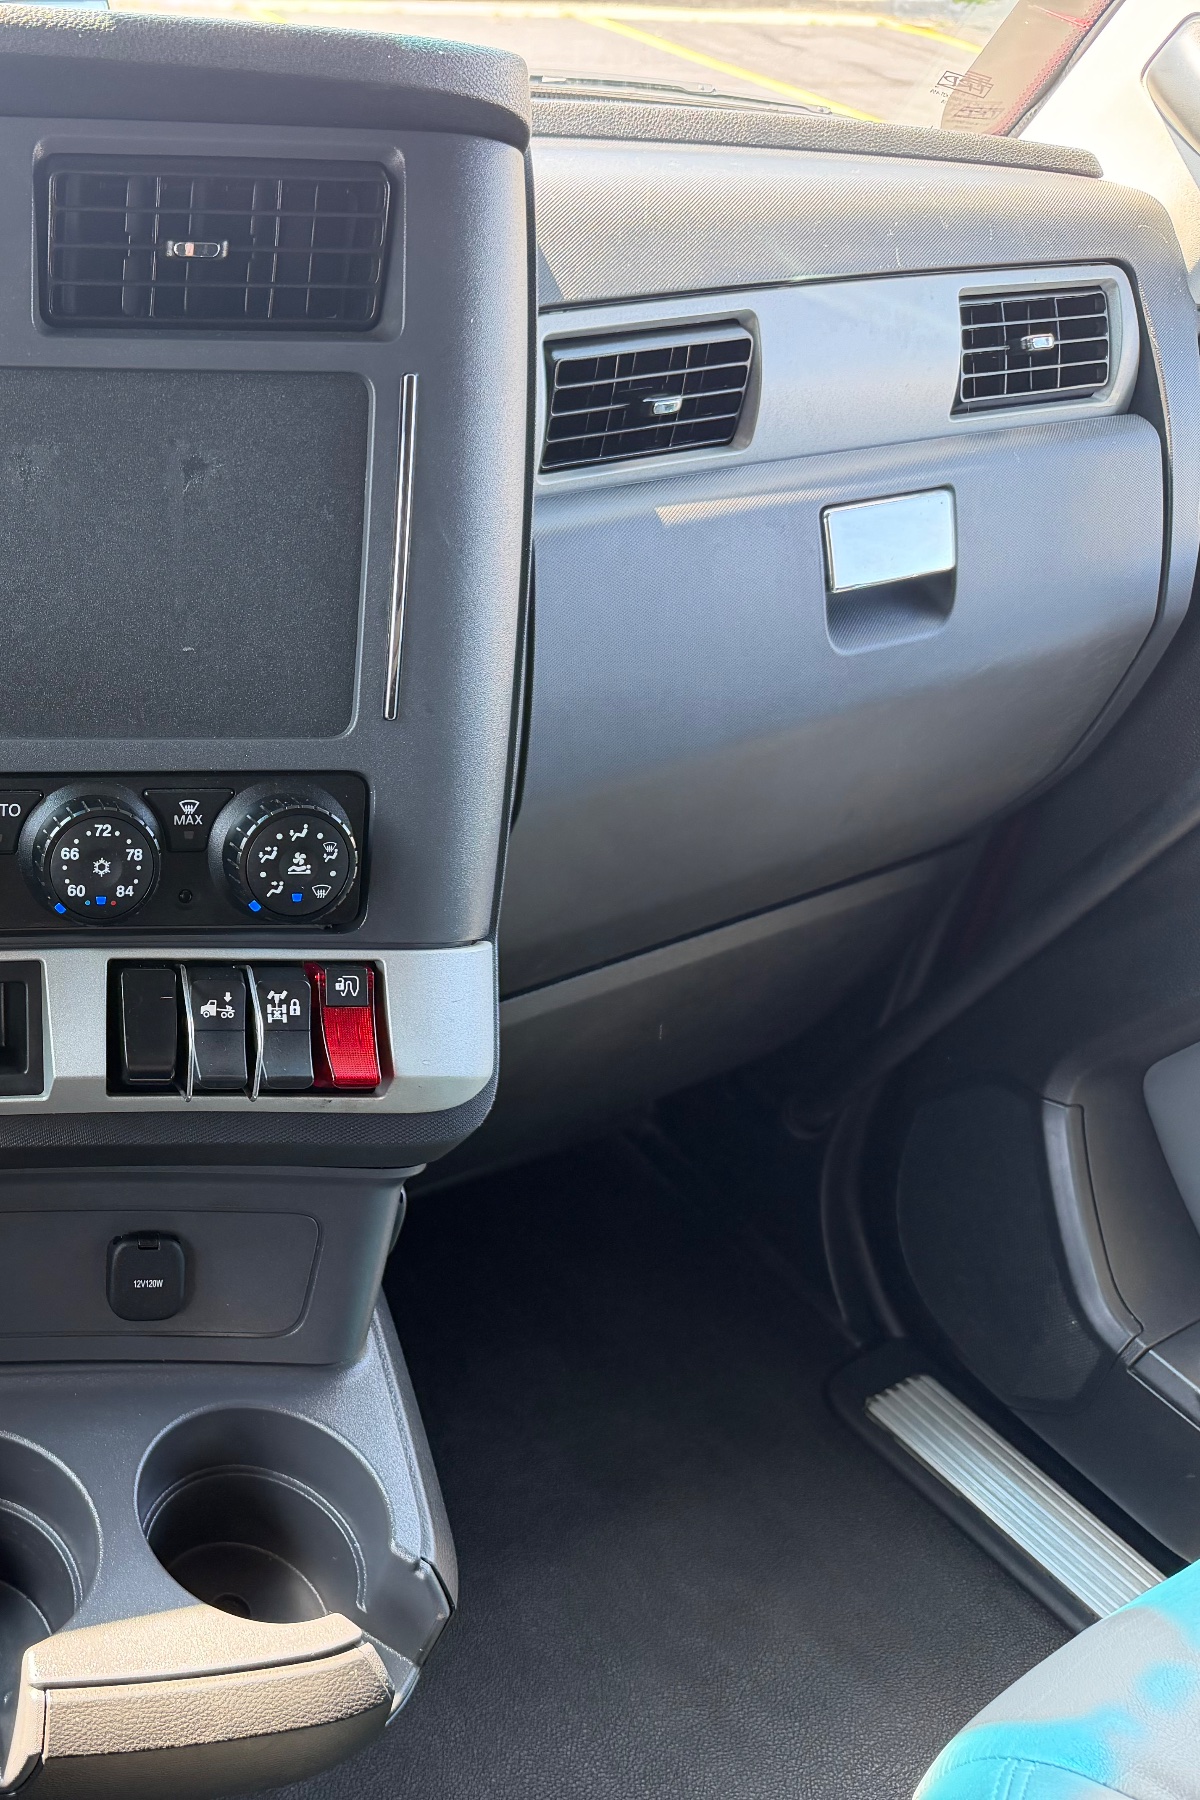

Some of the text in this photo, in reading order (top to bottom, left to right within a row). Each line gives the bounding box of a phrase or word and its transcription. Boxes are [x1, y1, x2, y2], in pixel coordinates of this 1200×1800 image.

[174, 814, 202, 826] MAX
[94, 824, 112, 837] 72
[60, 847, 80, 861] 66
[125, 848, 143, 861] 78
[67, 884, 86, 897] 60
[116, 885, 134, 898] 84
[133, 1280, 164, 1288] 12V120W
